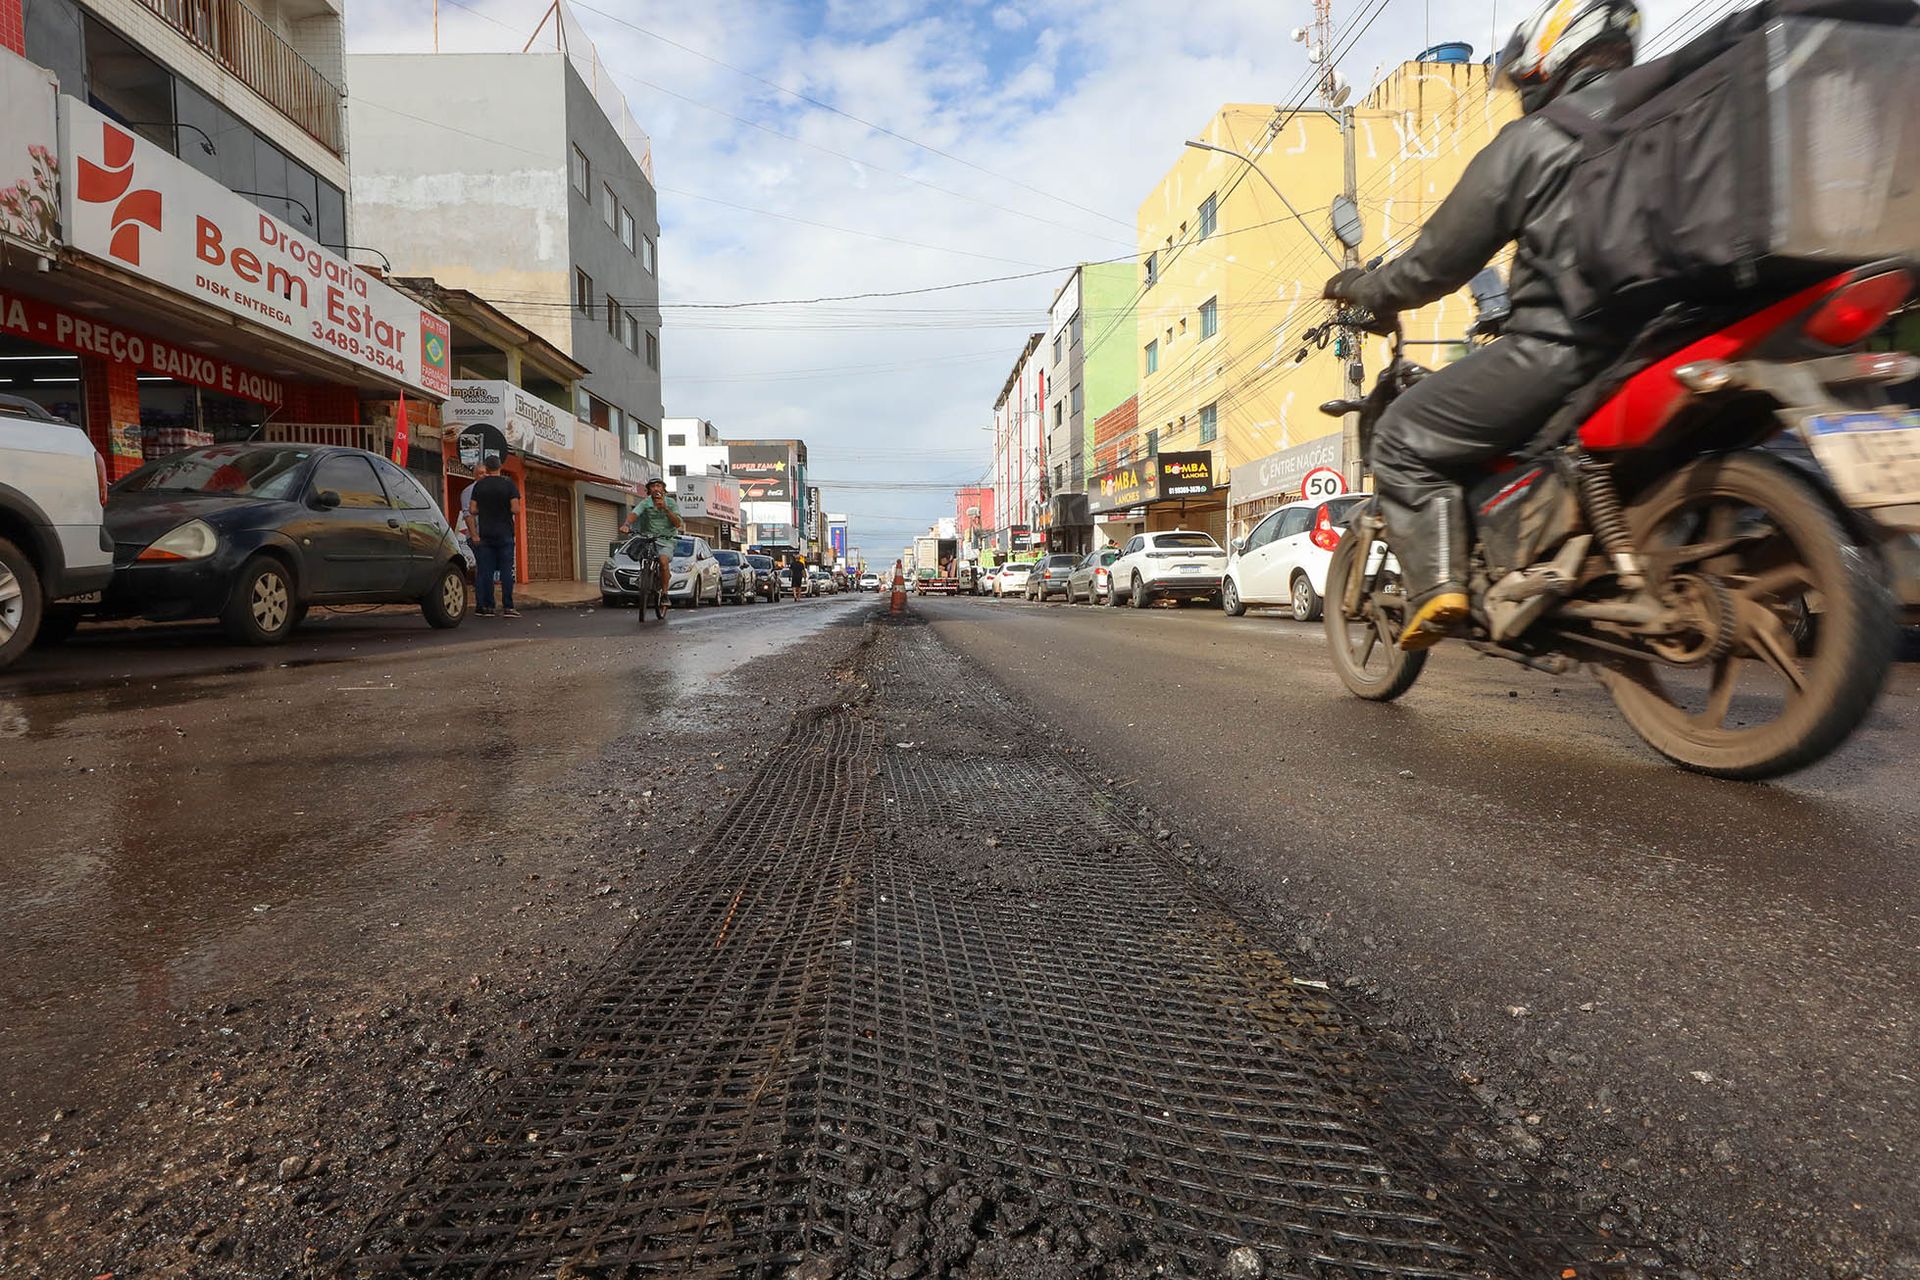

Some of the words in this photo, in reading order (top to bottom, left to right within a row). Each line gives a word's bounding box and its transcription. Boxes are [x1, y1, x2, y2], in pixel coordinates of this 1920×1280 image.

[259, 214, 367, 298] Drogaria
[196, 215, 308, 308] Bem
[327, 285, 405, 352] Estar
[196, 275, 230, 299] DISK
[234, 290, 292, 326] ENTREGA
[435, 322, 448, 336] TEM
[57, 313, 145, 364] PREÇO
[153, 343, 216, 385] BAIXO
[221, 364, 233, 390] É
[312, 321, 405, 374] 3489-3544
[421, 375, 448, 393] POPULAR
[455, 408, 494, 416] 99550-2500
[515, 393, 557, 430] Empório
[1164, 462, 1208, 475] BOMBA
[1270, 456, 1296, 478] ENTRE
[1297, 444, 1335, 470] NAÇÕES
[1310, 478, 1337, 495] 50
